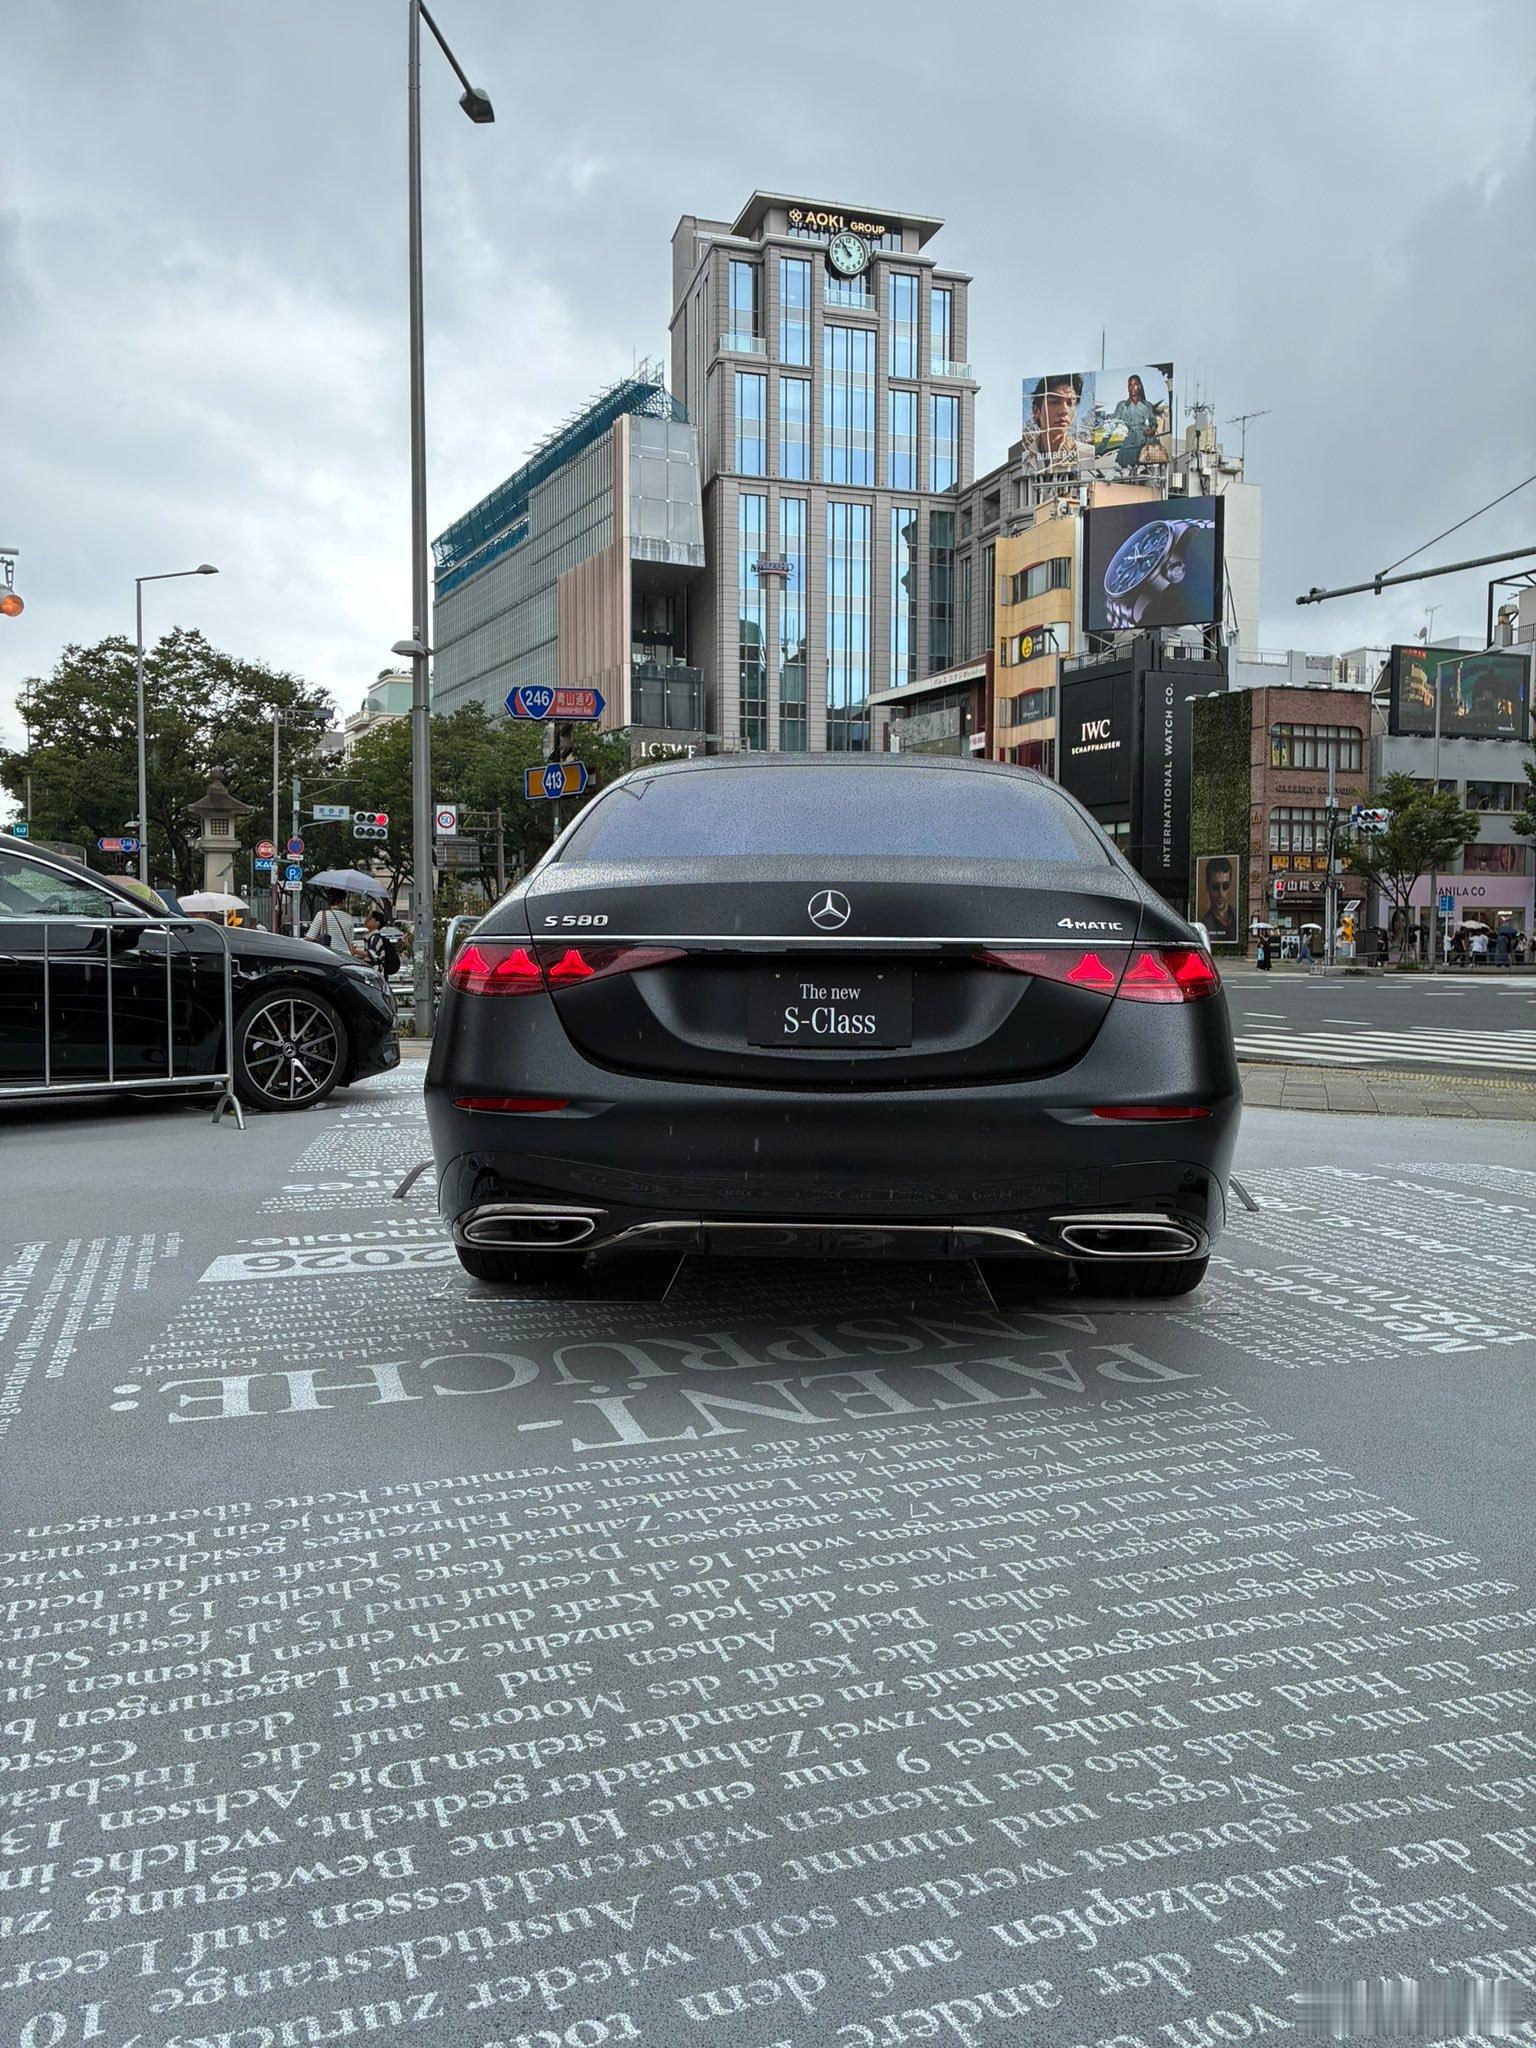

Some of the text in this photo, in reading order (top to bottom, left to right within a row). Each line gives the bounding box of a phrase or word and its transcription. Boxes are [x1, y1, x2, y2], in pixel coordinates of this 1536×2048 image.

[806, 212, 886, 234] AOKI GROUP
[525, 690, 550, 706] 246
[1071, 740, 1121, 755] SCHAFFHAUSEN
[1081, 718, 1111, 742] IWC
[441, 816, 452, 824] 50
[545, 773, 562, 789] 413
[1163, 683, 1175, 868] INTERNATIONAL WATCH CO.
[544, 914, 609, 927] S 580
[1057, 917, 1123, 931] 4MATIC
[1287, 880, 1345, 892] 山陽堂店
[1471, 887, 1486, 896] CO
[783, 1006, 877, 1035] S-Class
[799, 983, 861, 1000] The new
[236, 1228, 448, 1248] mobile.
[242, 1247, 457, 1273] 2026
[108, 1310, 1100, 1424] ANSPRÜCHE:
[128, 1358, 258, 1376] folgende
[283, 1346, 405, 1361] welchem
[428, 1340, 469, 1350] bei
[517, 1342, 1201, 1450] PATENT-
[12, 1406, 1090, 1538] welche Kraft vermittelst Kette übertragen.
[101, 1451, 1005, 1576] wodurch Lenkbarkeit Fahrzeuges gesichert
[271, 1441, 1236, 1584] bekannter Weise konische Zahnräder Kraft
[321, 1408, 1205, 1525] beiden Achsen tragen Enden
[106, 1465, 1356, 1657] Scheiben übertragen, wobei feste
[237, 1459, 1244, 1611] Eine Bremsscheibe angegossen. Diese Scheibe
[57, 1506, 1420, 1729] Fuhrwerkes gelagert, zwar einzelne zwei Lagerungen
[64, 1503, 1258, 1694] Riemscheibe Motors Kraft durch einen Riemen
[332, 1530, 1455, 1718] Wagens übermitteln sollen. Beide Achsen unter
[448, 1551, 1482, 1732] sind Vorgelegewellen, welche Kraft Motors
[98, 1579, 1520, 1831] starkem einander Achsen
[71, 1645, 1320, 1883] diese Kurbel durch zwei Zahnräder gedreht, welche
[83, 1660, 1477, 1923] die Hand Punkt bei 9 eine kleine Bewegung
[309, 1705, 1431, 1929] mit, also Riemen währenddessen
[19, 1748, 1430, 2047] seines Weges, nimmt Ausrückstange 10
[466, 1793, 1456, 2012] wenn gebremst werden soll, wieder
[677, 1837, 1478, 2023] der Kurbelzapfen auf dem
[1089, 1892, 1509, 1998] länger als der
